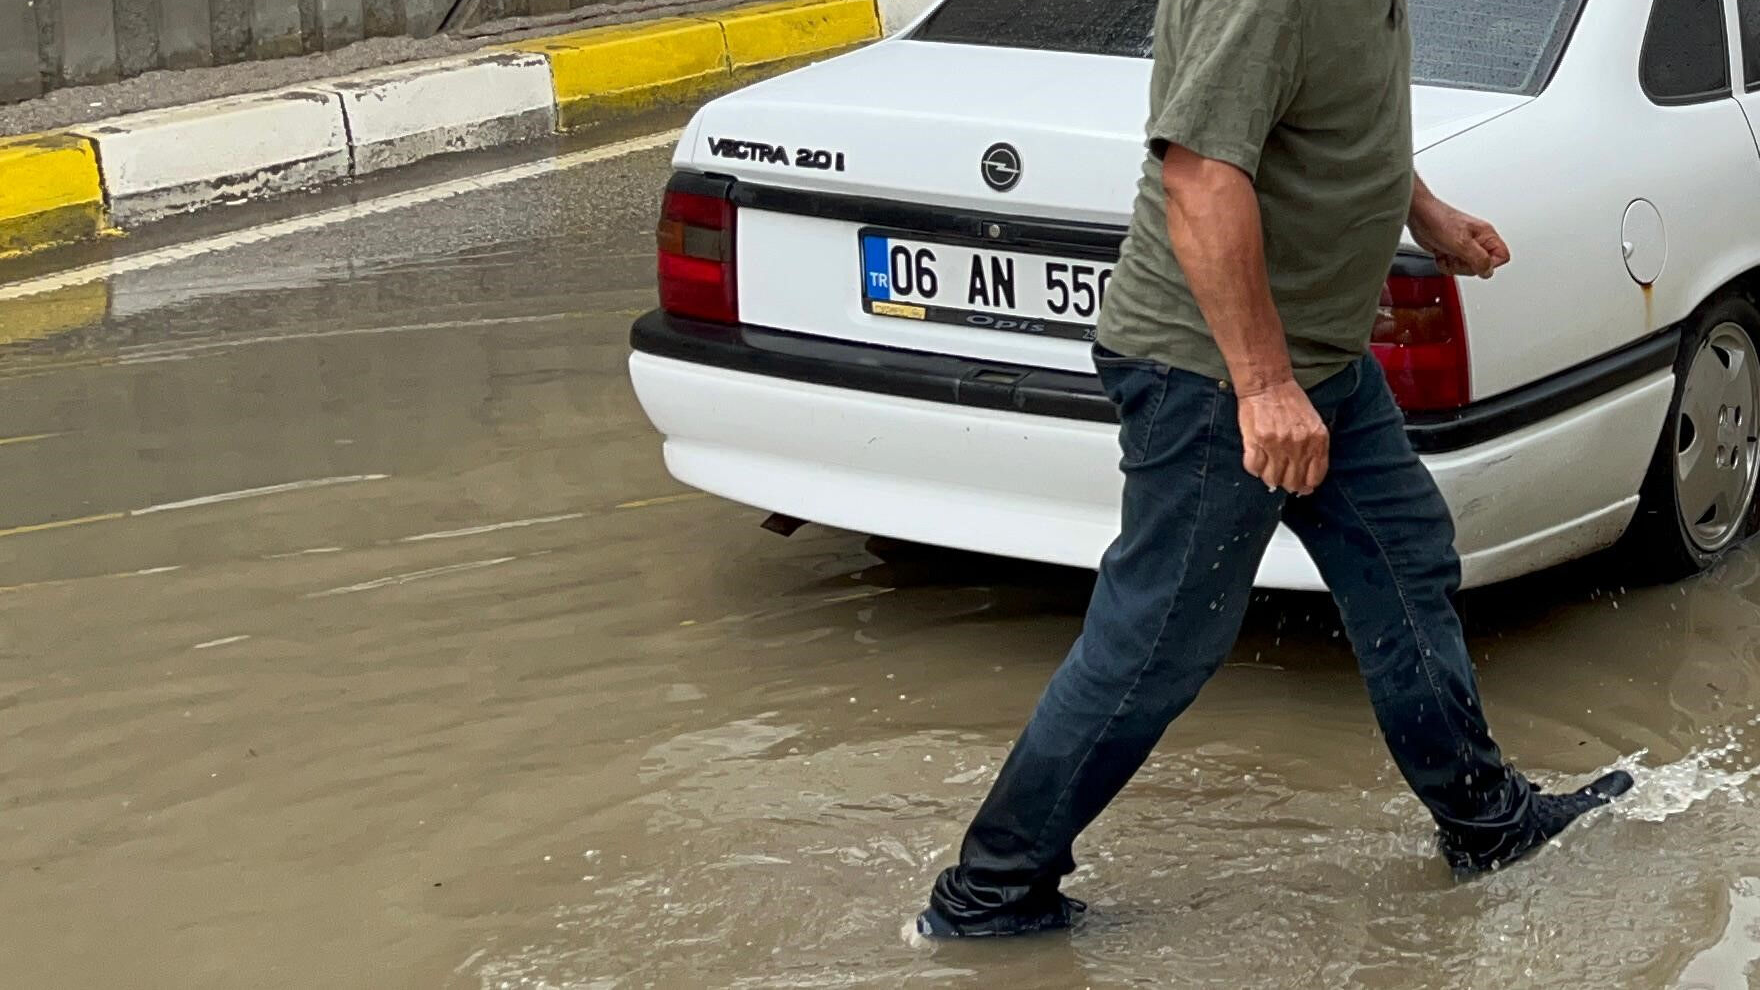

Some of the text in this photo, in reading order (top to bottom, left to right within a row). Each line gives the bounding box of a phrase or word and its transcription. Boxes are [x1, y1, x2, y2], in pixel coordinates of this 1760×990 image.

[708, 137, 790, 166] VECTRA
[870, 271, 889, 288] TR
[890, 245, 938, 298] 06
[968, 254, 1015, 309] AN
